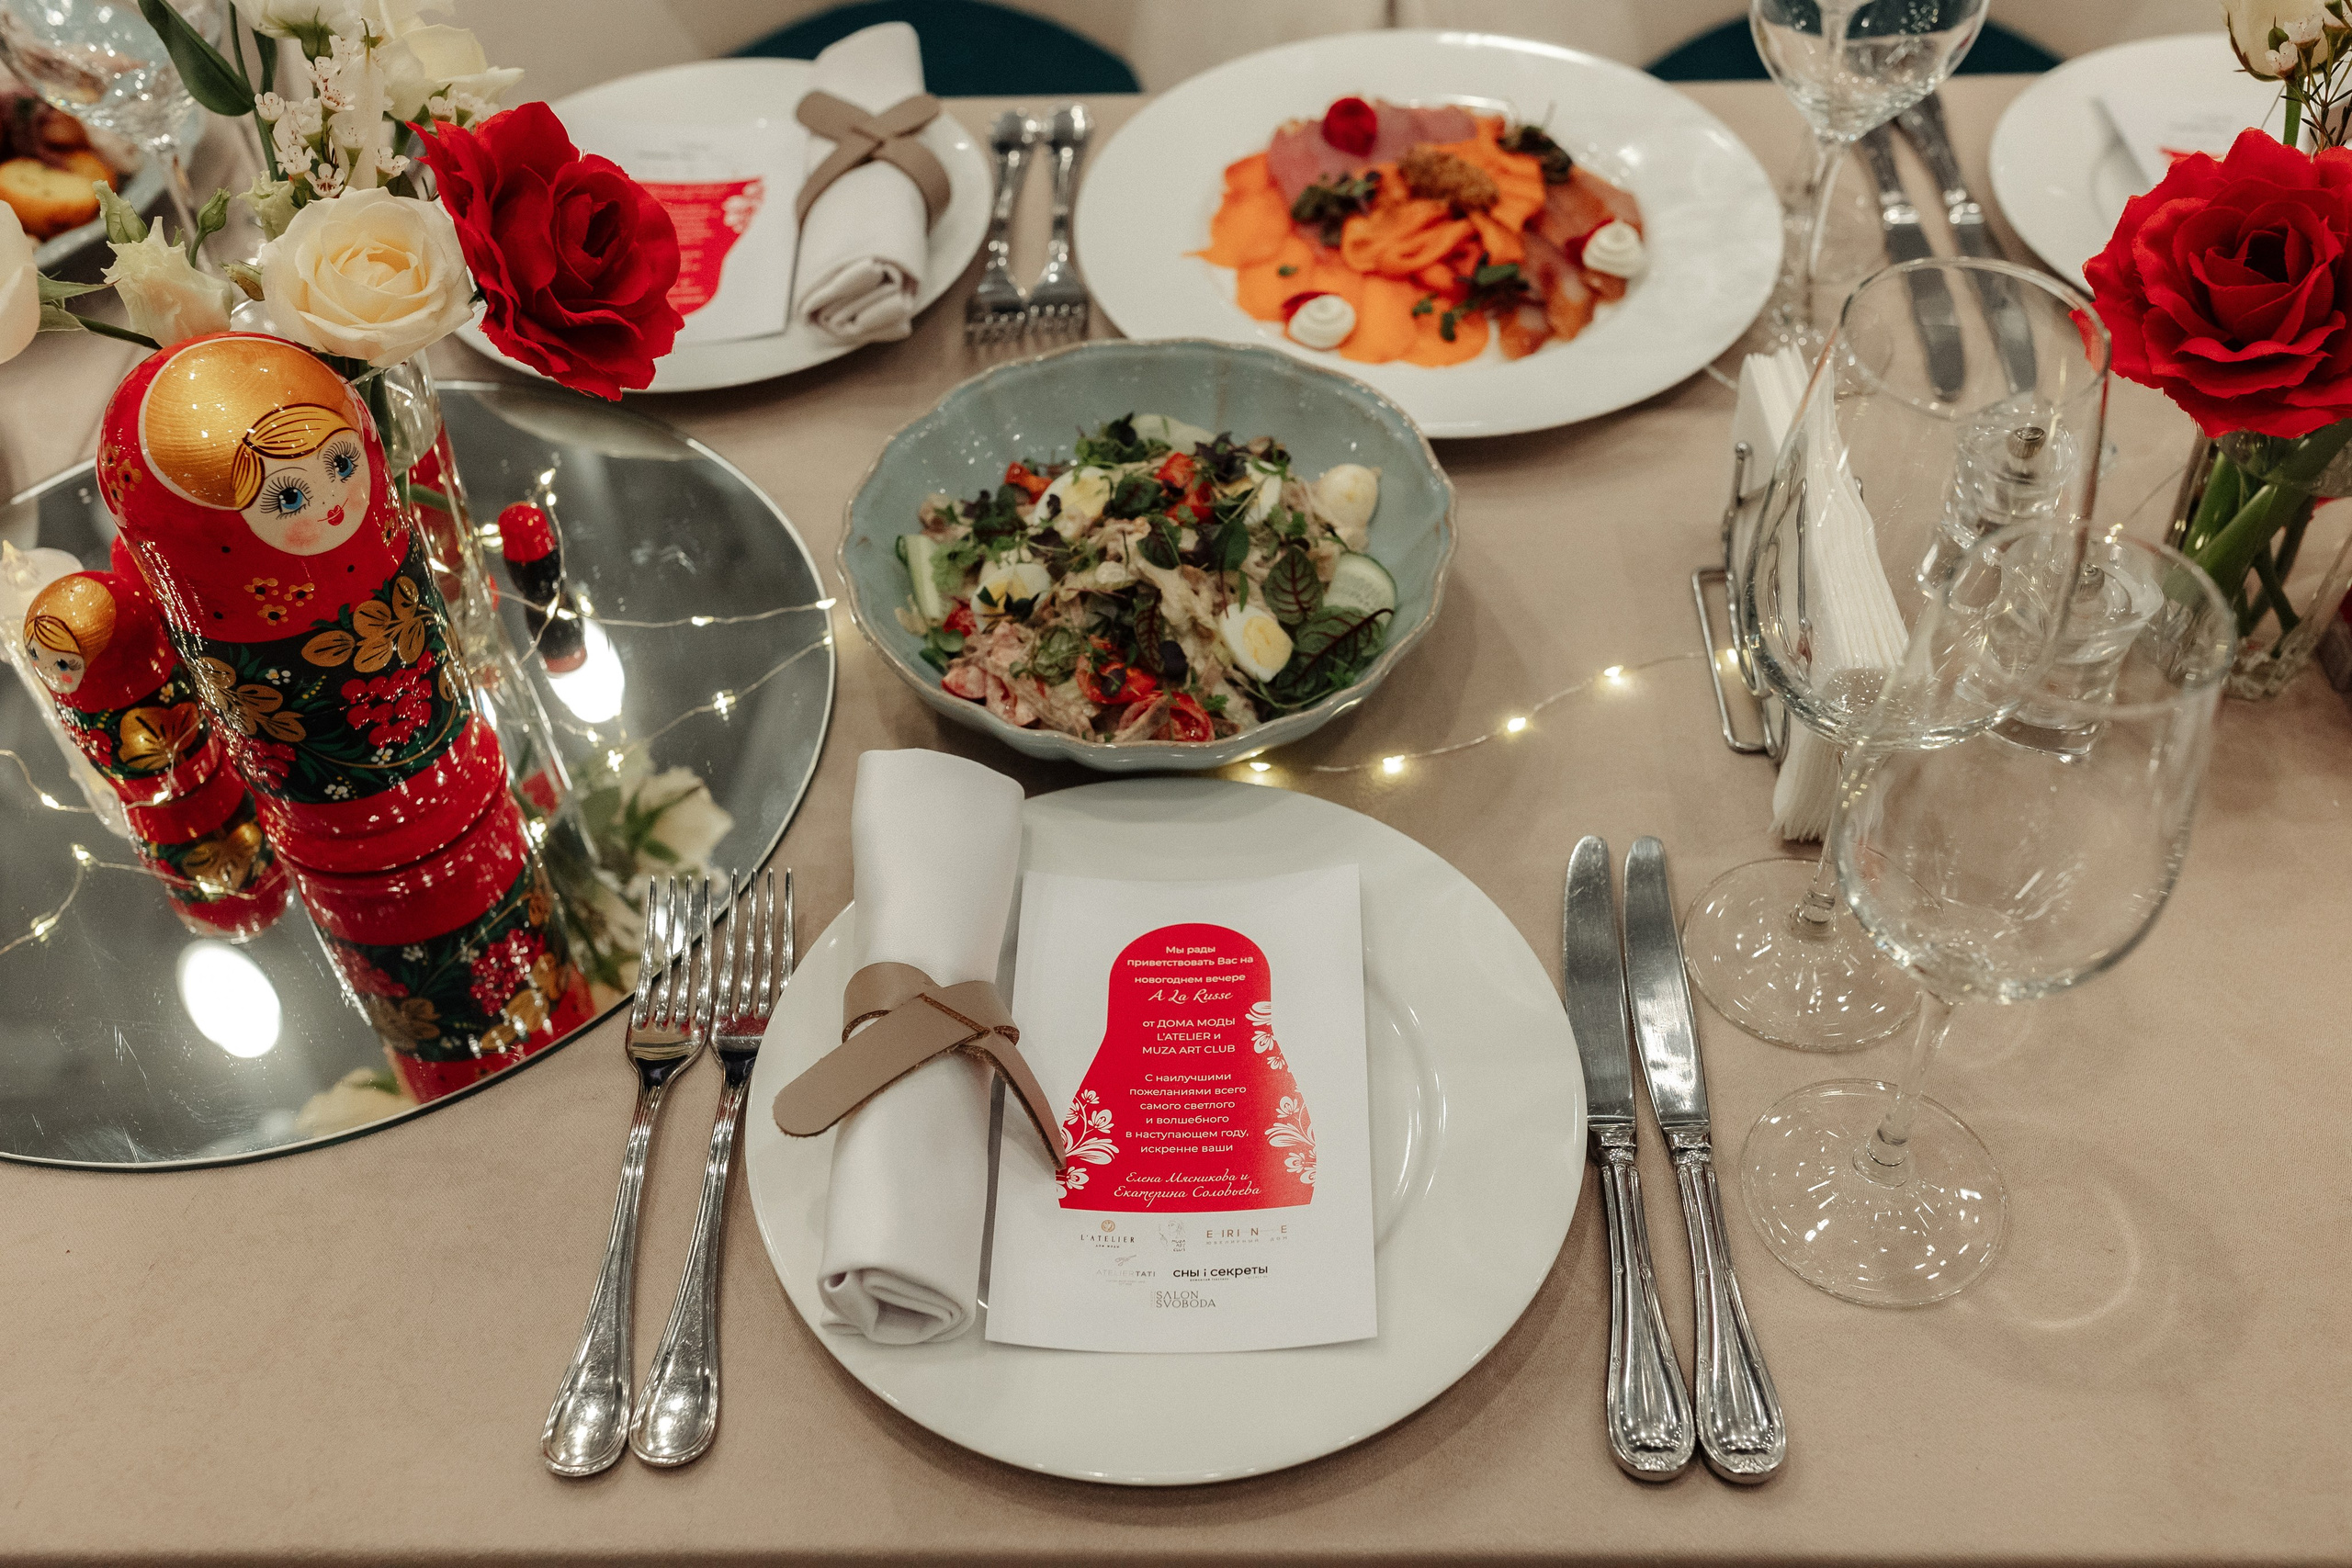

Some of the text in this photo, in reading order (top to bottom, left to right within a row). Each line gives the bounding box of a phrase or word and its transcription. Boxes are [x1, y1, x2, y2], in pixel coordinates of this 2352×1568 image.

[1187, 946, 1216, 954] рады
[1127, 959, 1215, 967] приветствовать
[1206, 975, 1246, 983] вечере
[1148, 988, 1233, 1004] A La Russe
[1157, 1020, 1194, 1028] ДОМА
[1197, 1018, 1236, 1027] МОДЫ
[1142, 1044, 1236, 1055] MUZA ART CLUB
[1145, 1074, 1231, 1083] С наилучшими
[1130, 1087, 1247, 1096] пожеланиями всего
[1183, 1101, 1236, 1110] светлого
[1157, 1115, 1229, 1124] волшебного
[1136, 1130, 1218, 1140] наступающем
[1140, 1145, 1233, 1155] искренне ваши
[1125, 1172, 1162, 1183] Елена
[1165, 1168, 1238, 1183] Мясникова
[1114, 1181, 1261, 1208] Екатерина Соловьева
[1173, 1269, 1199, 1278] сны
[1210, 1266, 1268, 1278] секреты
[1156, 1291, 1199, 1300] SALON
[1156, 1299, 1216, 1308] SVOBODA
